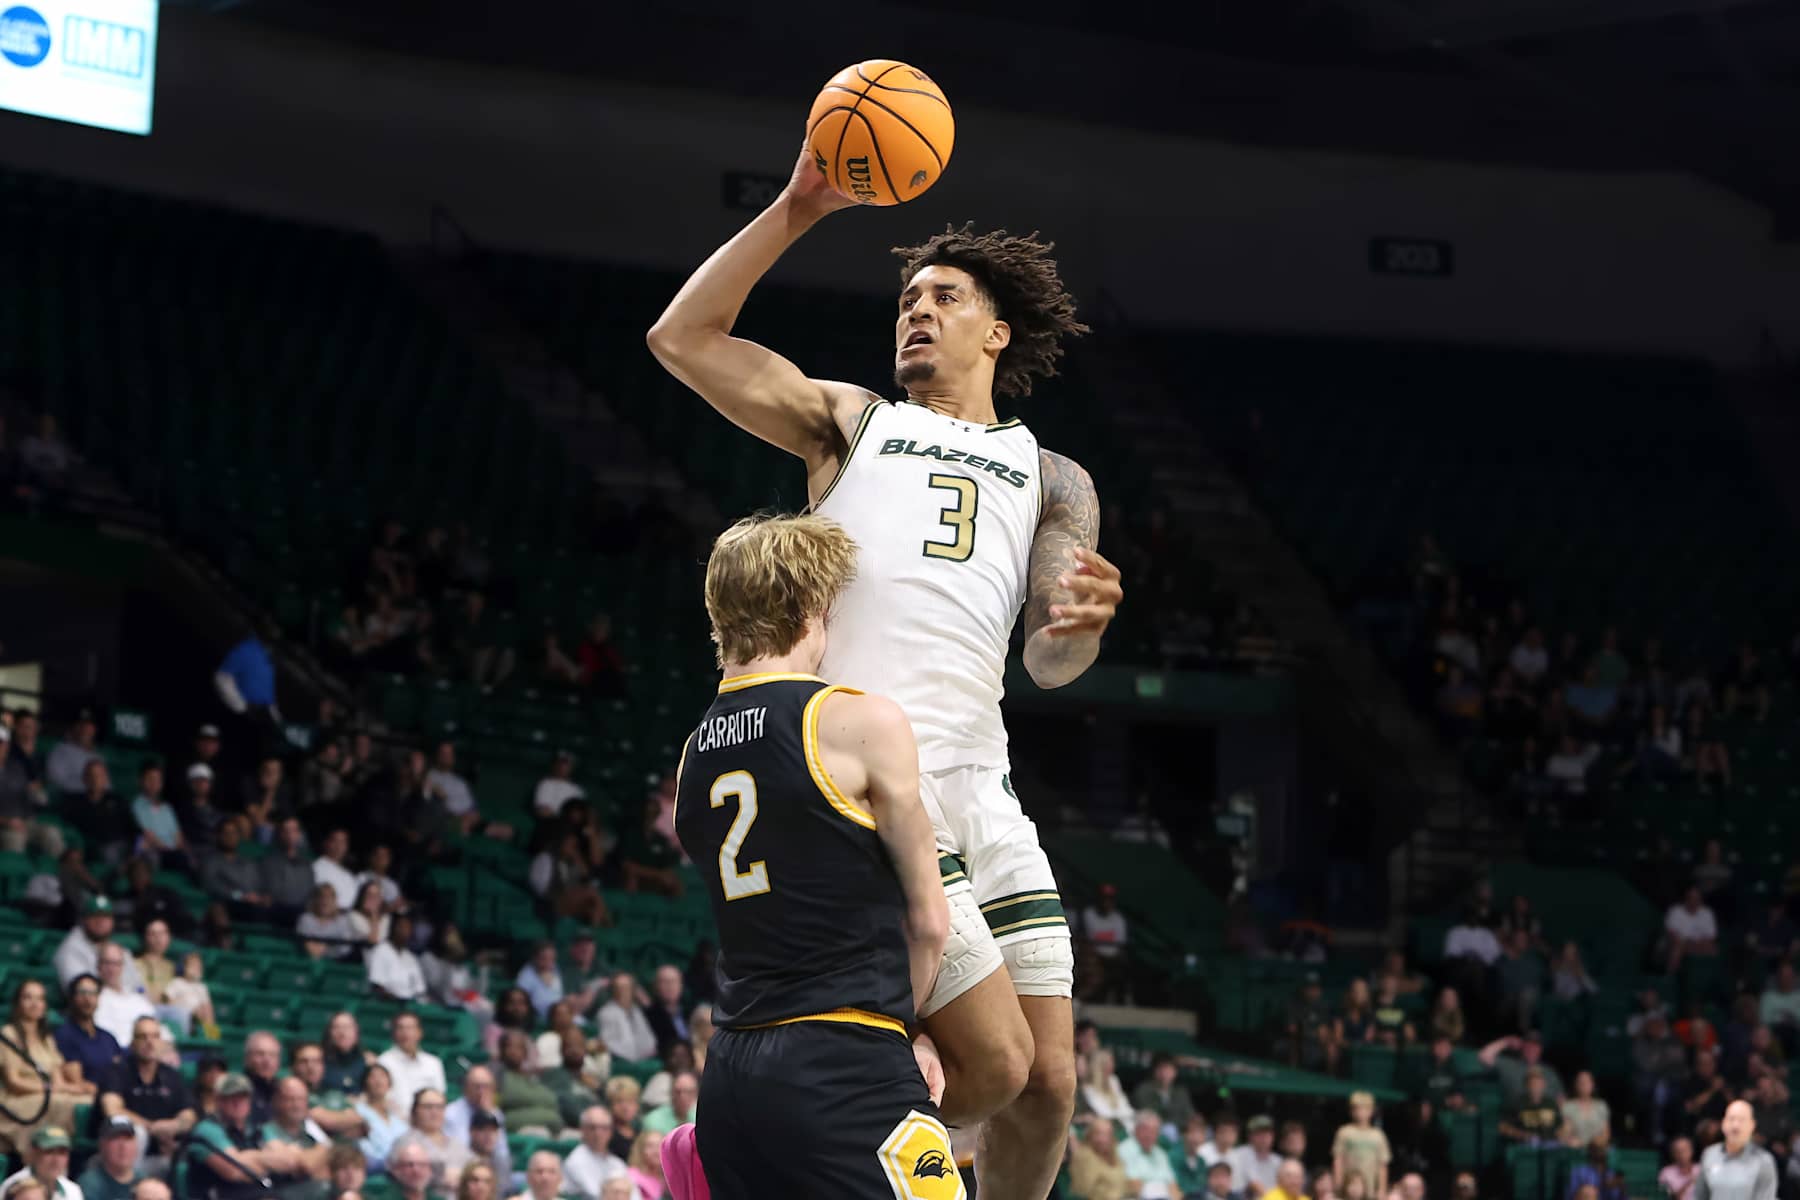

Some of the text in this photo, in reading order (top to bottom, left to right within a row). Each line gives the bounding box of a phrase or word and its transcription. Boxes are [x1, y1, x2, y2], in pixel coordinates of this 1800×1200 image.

[739, 177, 782, 208] 20
[879, 439, 1029, 489] BLAZERS
[923, 473, 979, 562] 3
[698, 707, 767, 752] CARRUTH
[710, 769, 772, 902] 2
